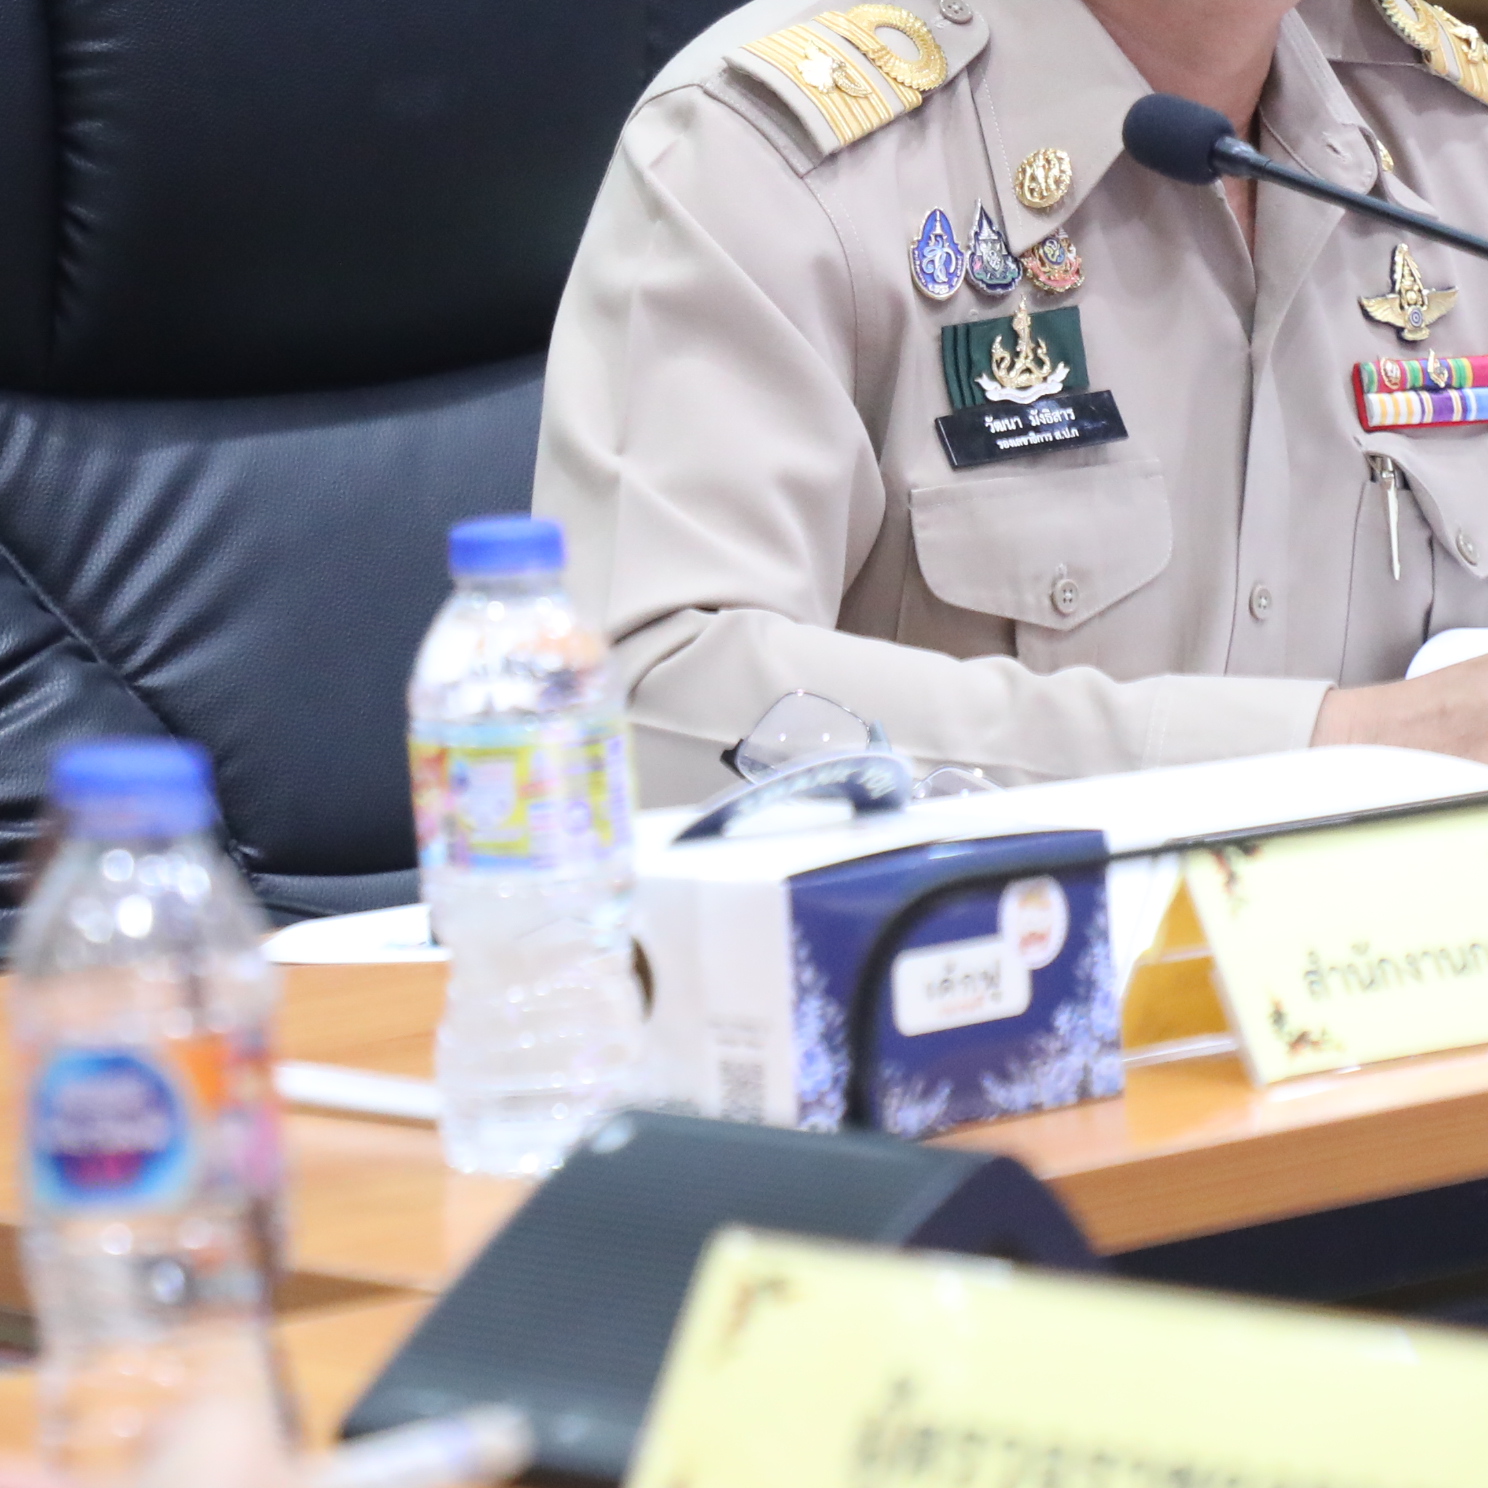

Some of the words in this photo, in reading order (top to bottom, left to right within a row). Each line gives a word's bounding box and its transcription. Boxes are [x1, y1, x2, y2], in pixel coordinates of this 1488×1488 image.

[984, 415, 1023, 434] วัฒนา
[996, 430, 1053, 450] รองเลขาธิการ
